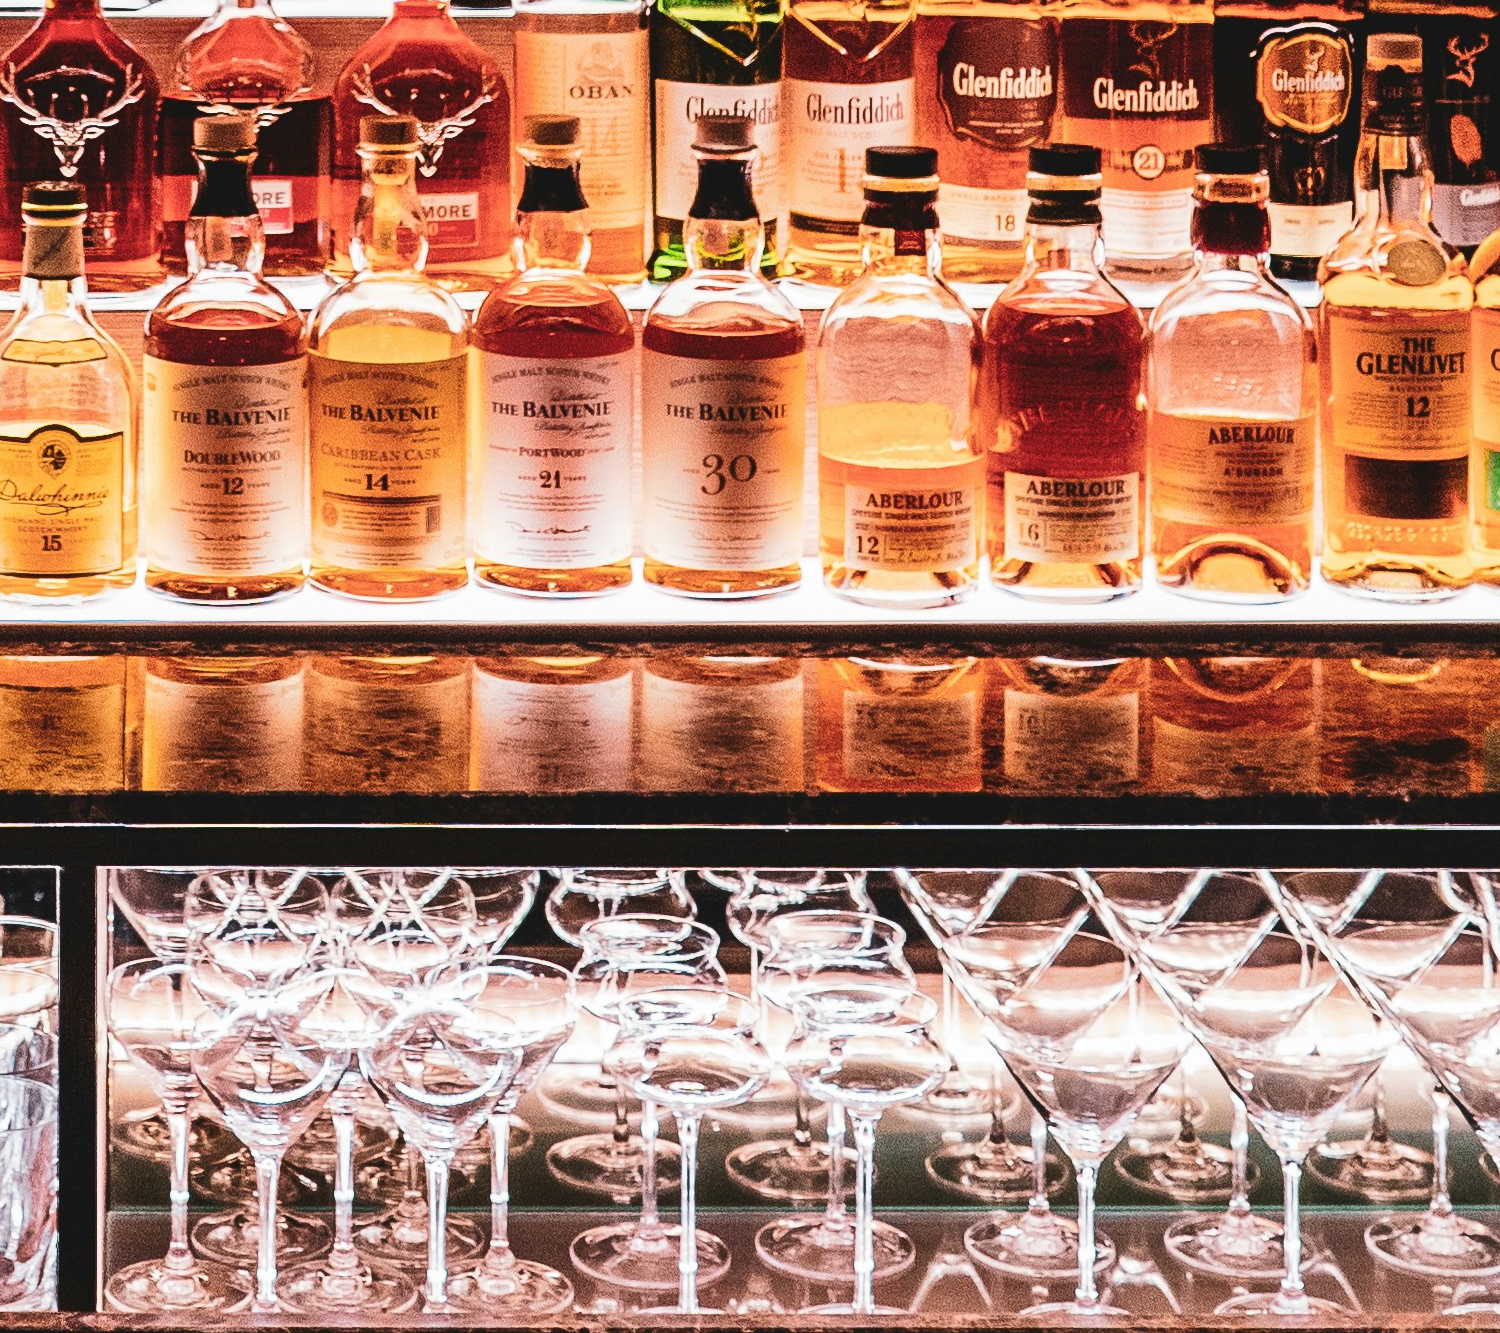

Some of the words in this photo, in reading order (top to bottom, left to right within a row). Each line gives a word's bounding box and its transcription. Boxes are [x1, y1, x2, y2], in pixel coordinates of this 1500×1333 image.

[1271, 68, 1346, 93] Glenfiddich
[568, 83, 635, 99] OBAN
[1093, 76, 1200, 114] Glenfiddich
[685, 93, 779, 126] Glenfiddic
[806, 92, 904, 126] Glenfiddich
[1138, 150, 1162, 171] 21
[422, 204, 472, 219] MORE
[995, 213, 1016, 232] 18
[1400, 336, 1437, 354] THE
[1355, 352, 1466, 376] GLENLIVET
[172, 409, 201, 425] THE
[205, 406, 293, 426] BALVENIE
[321, 404, 348, 421] THE
[350, 402, 441, 423] BALVENIE
[491, 401, 519, 418] THE
[522, 399, 612, 420] BALVENIE
[665, 403, 695, 420] THE
[698, 402, 789, 423] BALVENIE
[1405, 396, 1431, 418] 12
[1208, 426, 1295, 445] ABERLOUR
[183, 448, 281, 467] DOUBLEWOOD
[321, 446, 401, 463] CARIBBEAN
[403, 445, 442, 461] CASK
[518, 445, 586, 460] PORTWOOD
[364, 472, 390, 492] 14
[538, 468, 562, 489] 21
[700, 453, 758, 496] 30
[222, 476, 245, 496] 12
[1026, 479, 1126, 498] ABERLOUR
[866, 490, 964, 510] ABERLOUR
[1016, 523, 1041, 542] 16
[41, 535, 62, 552] 15
[856, 535, 880, 556] 12
